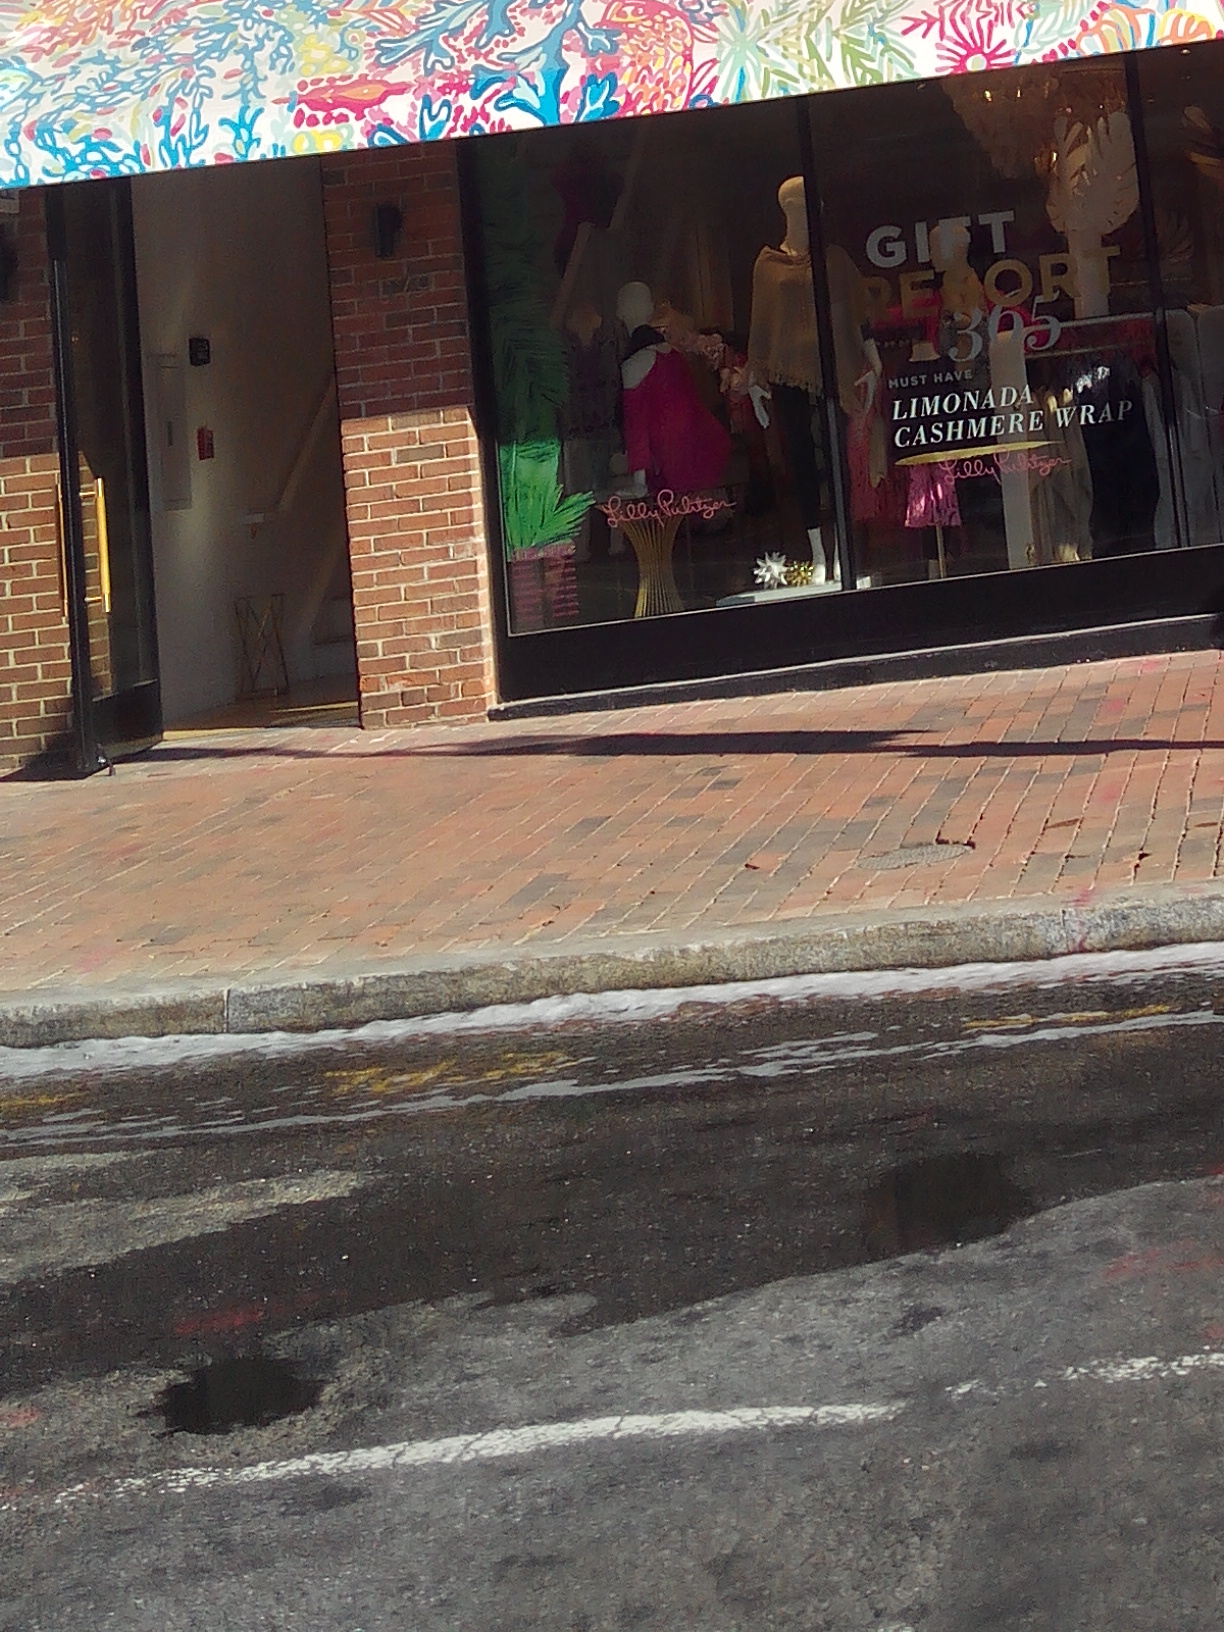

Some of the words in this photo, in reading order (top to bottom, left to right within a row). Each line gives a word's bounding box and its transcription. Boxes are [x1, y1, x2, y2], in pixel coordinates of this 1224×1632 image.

[865, 210, 1015, 268] GIFT
[858, 245, 1121, 324] REORT
[948, 288, 1063, 362] 365
[888, 373, 929, 389] MUST
[933, 369, 973, 384] HAVE
[892, 384, 1034, 420] LIMONADA
[894, 411, 1044, 448] CASHMERE
[1055, 400, 1133, 428] WRAP
[938, 455, 1001, 485] Lilly
[602, 496, 664, 528] Lilly
[657, 489, 737, 519] Pulitzer
